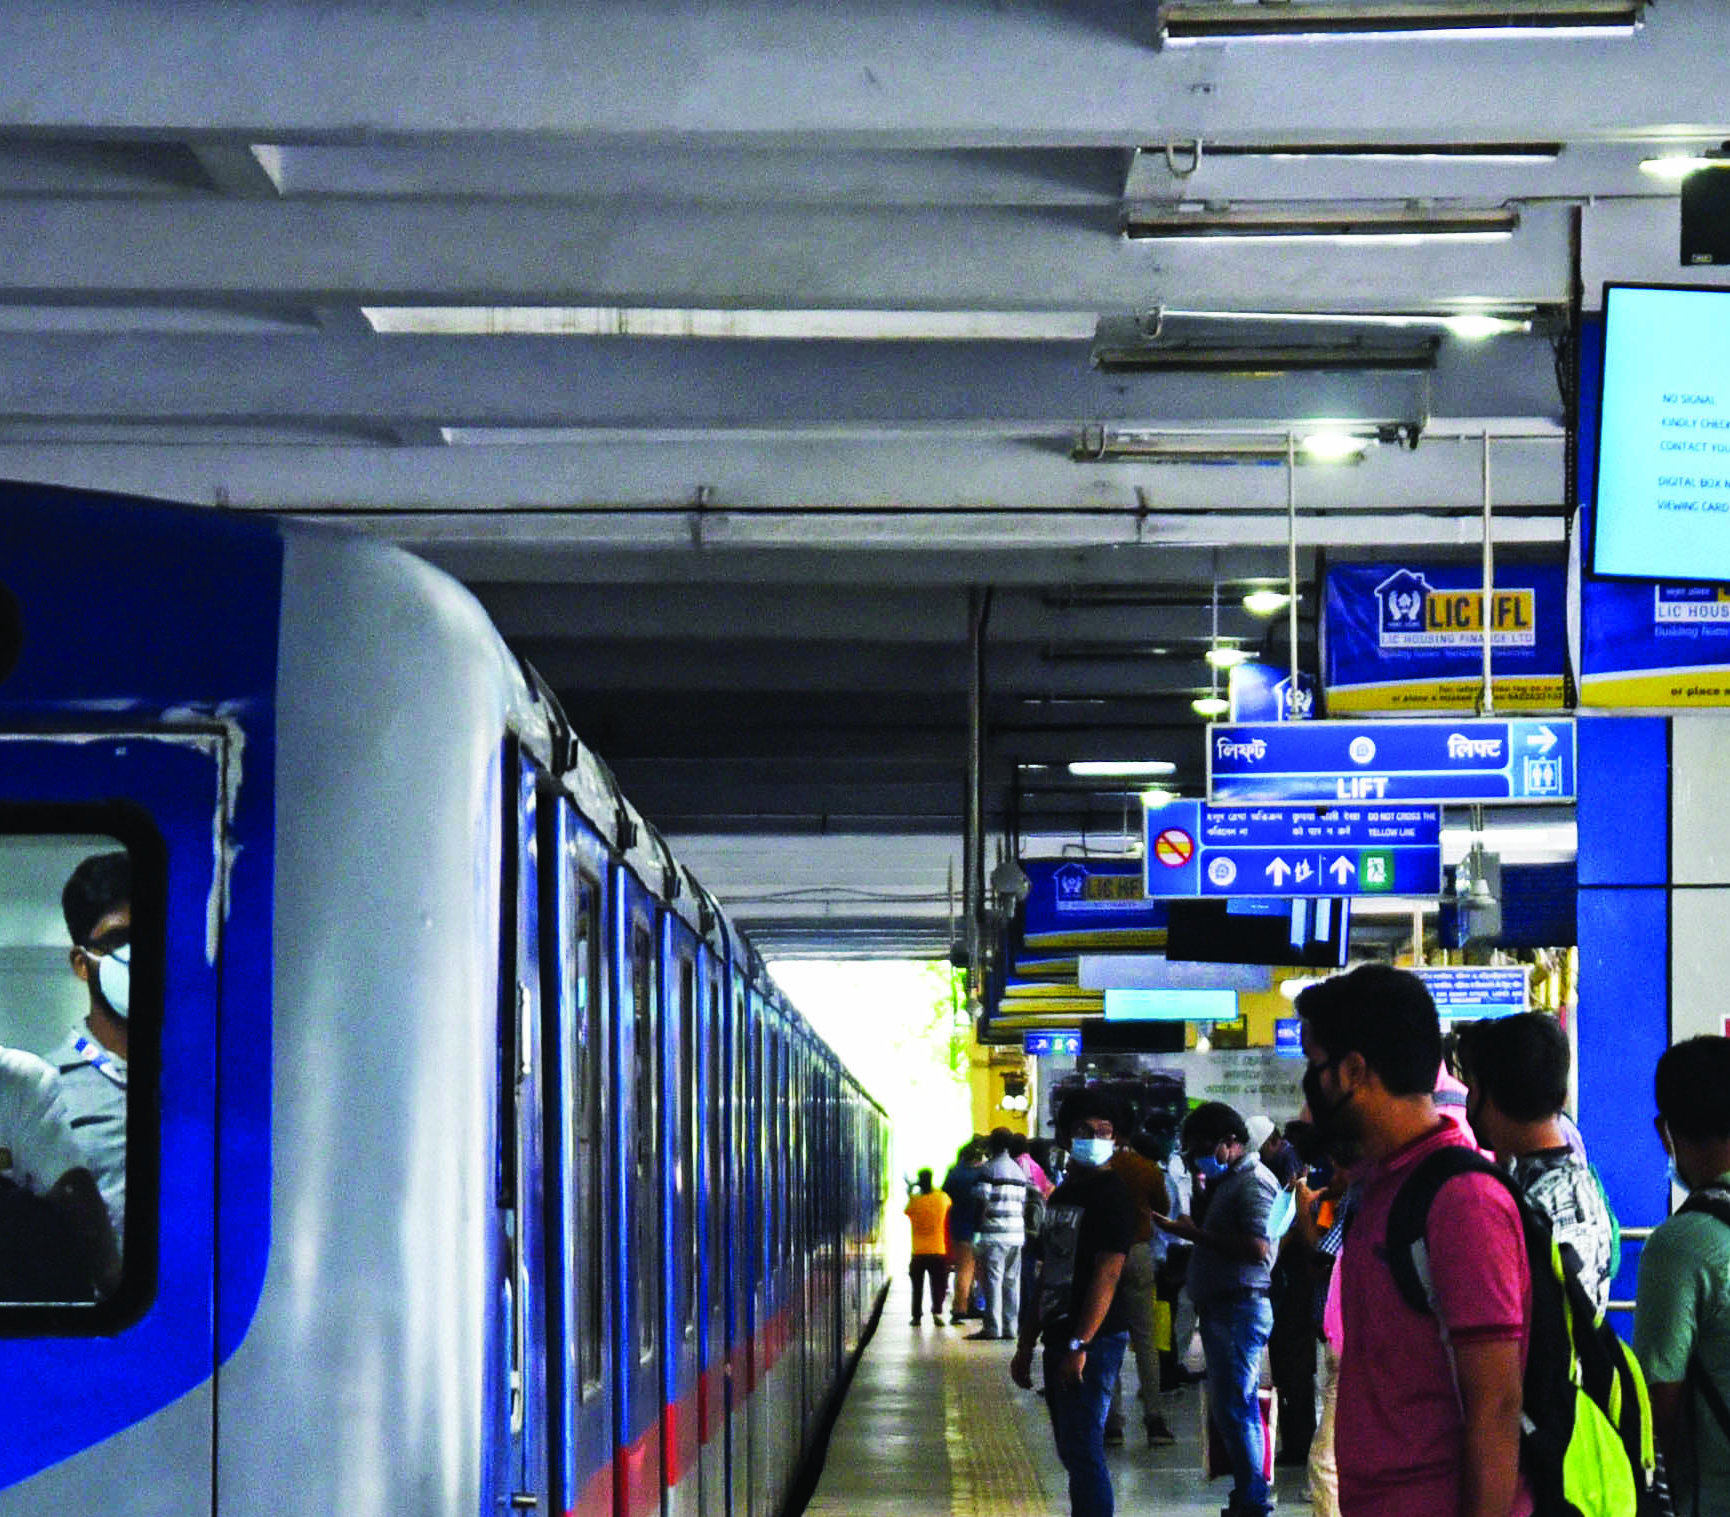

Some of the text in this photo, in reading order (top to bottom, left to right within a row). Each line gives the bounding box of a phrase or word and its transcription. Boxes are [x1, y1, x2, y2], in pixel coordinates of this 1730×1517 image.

[1681, 394, 1715, 405] SIGNAL
[1660, 441, 1708, 452] CONTACT
[1658, 476, 1696, 488] DIGITAL
[1700, 478, 1721, 489] BOX
[1701, 501, 1729, 513] CARD
[1429, 597, 1470, 628] LIC
[1658, 604, 1682, 618] LIC
[1447, 734, 1501, 759] लिफ्ट
[1337, 777, 1388, 799] LIFT
